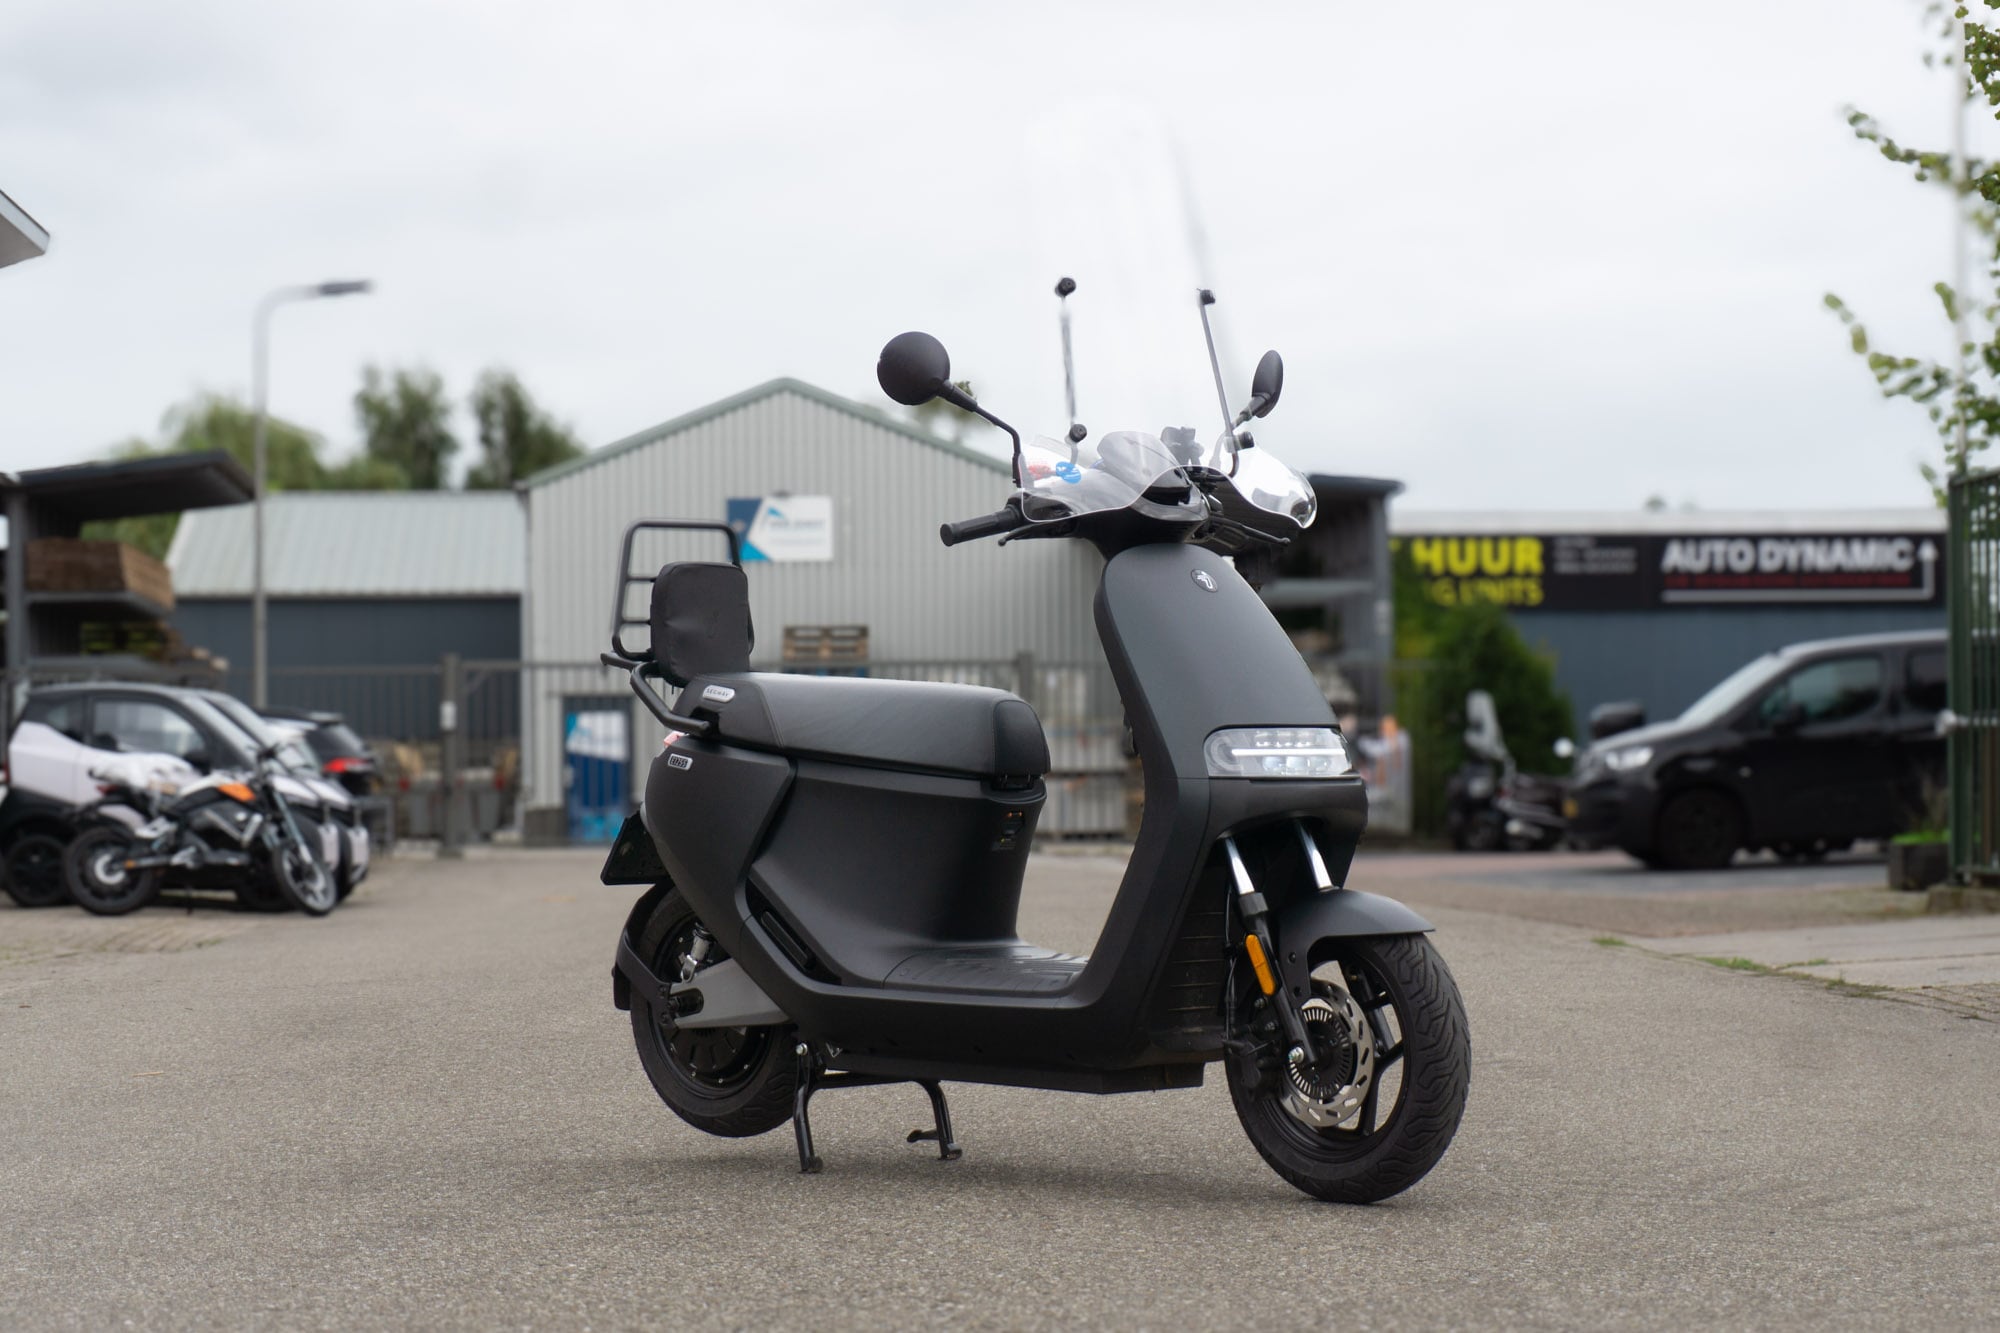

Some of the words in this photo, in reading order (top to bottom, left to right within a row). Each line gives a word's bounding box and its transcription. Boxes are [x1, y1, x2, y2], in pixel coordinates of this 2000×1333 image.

[1411, 536, 1544, 576] HUUR
[1661, 538, 1756, 573] AUTO
[1758, 538, 1914, 573] DYNAMIC
